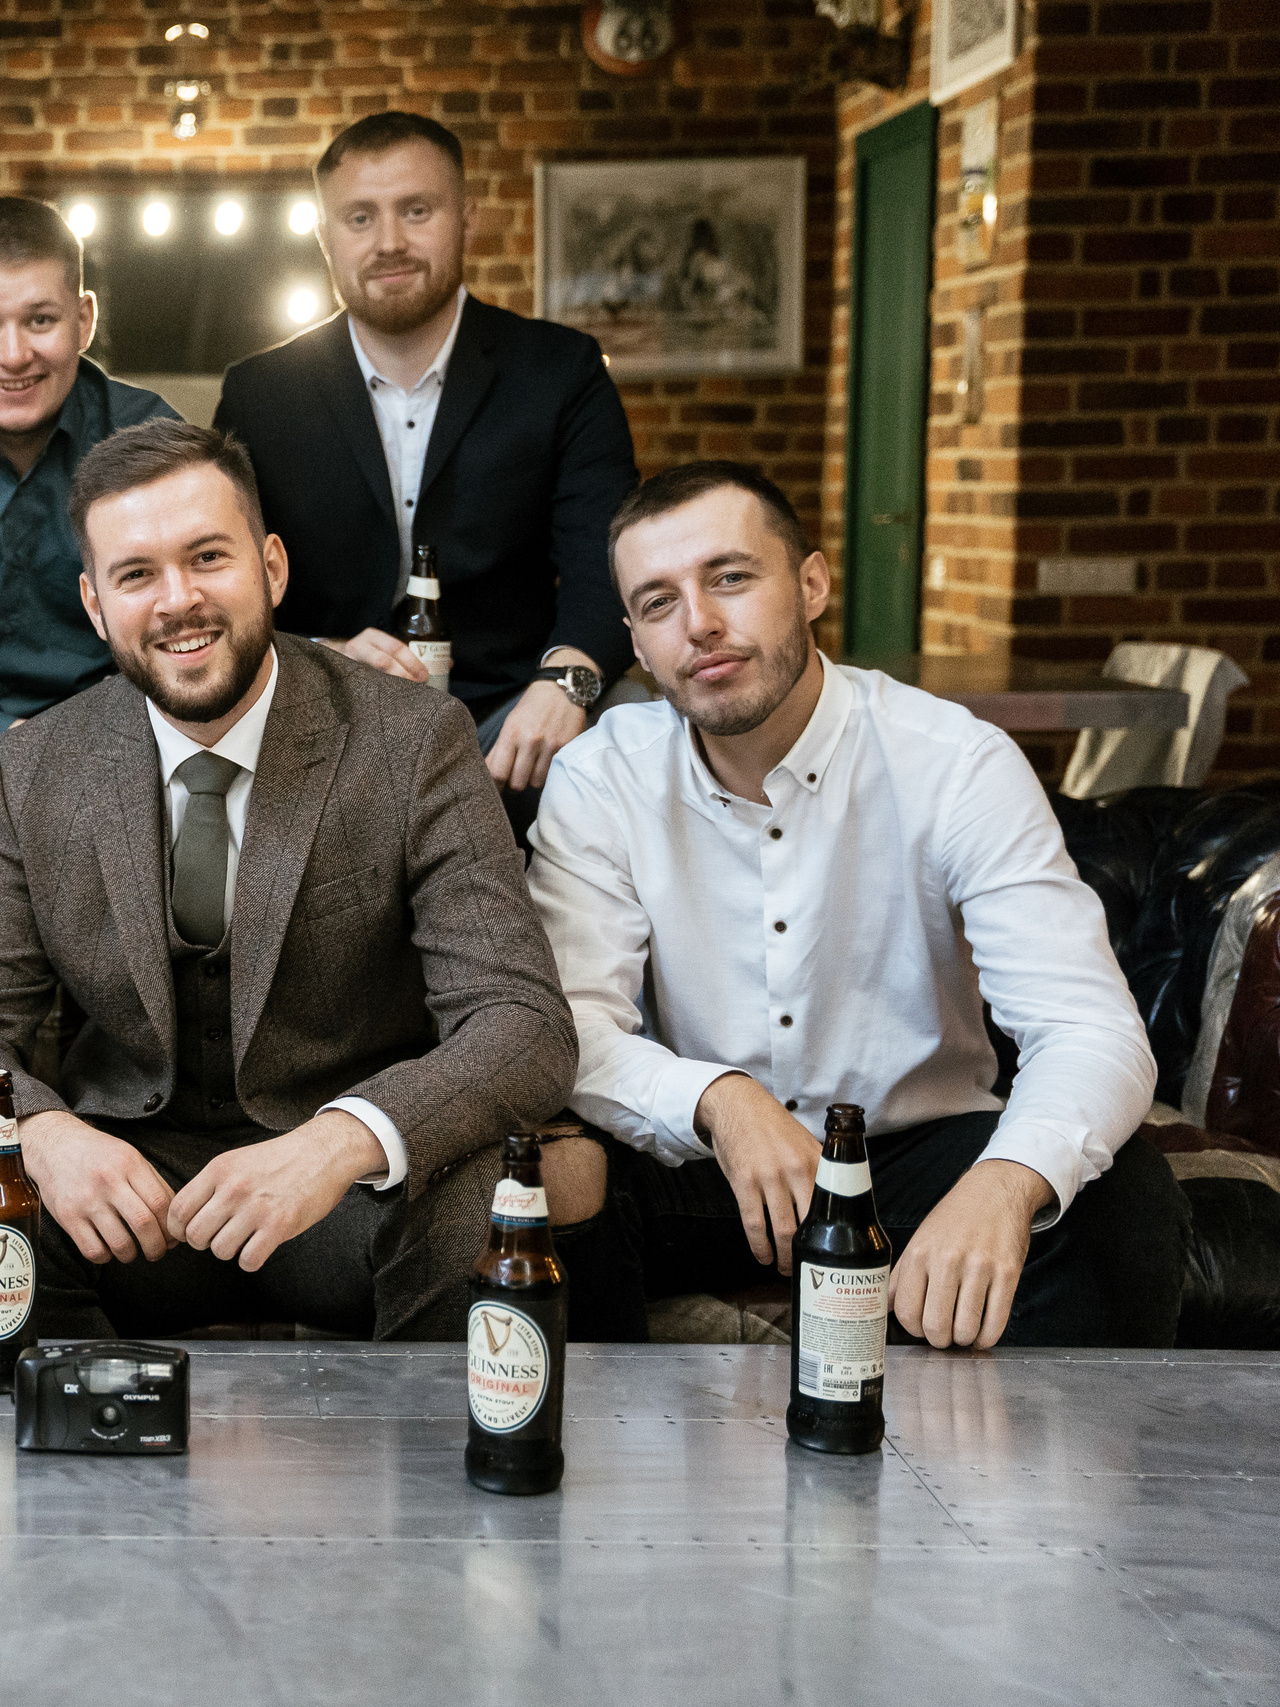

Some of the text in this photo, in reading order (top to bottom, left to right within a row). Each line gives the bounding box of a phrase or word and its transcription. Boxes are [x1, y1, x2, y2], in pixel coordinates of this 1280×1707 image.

[830, 1272, 886, 1285] GUINNESS
[836, 1286, 881, 1296] ORIGINAL
[517, 1323, 533, 1339] EXTRA
[468, 1350, 539, 1378] GUINNESS
[64, 1383, 79, 1393] DX
[470, 1373, 528, 1393] ORIGINAL
[495, 1398, 514, 1406] STOUT
[483, 1414, 498, 1423] AND
